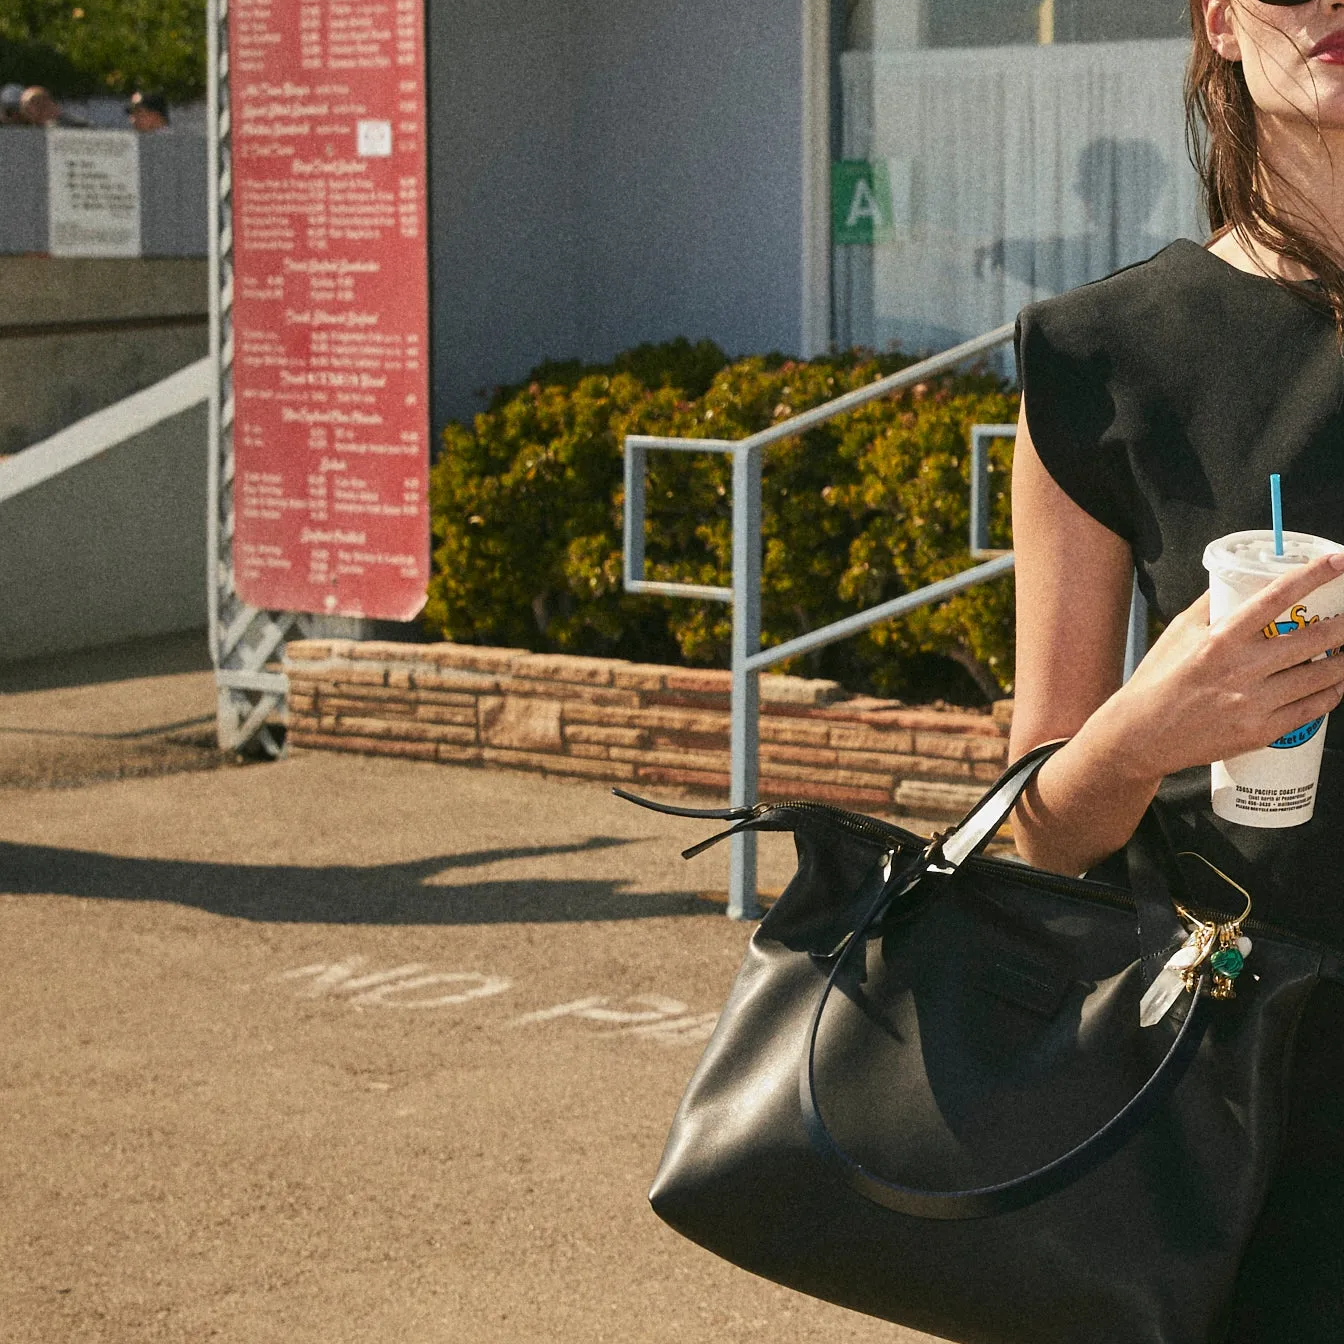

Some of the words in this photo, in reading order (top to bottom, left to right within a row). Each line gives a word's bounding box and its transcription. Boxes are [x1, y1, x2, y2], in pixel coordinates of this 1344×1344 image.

[845, 178, 883, 227] A
[1254, 788, 1278, 796] PACIFIC
[1279, 788, 1296, 796] COAST
